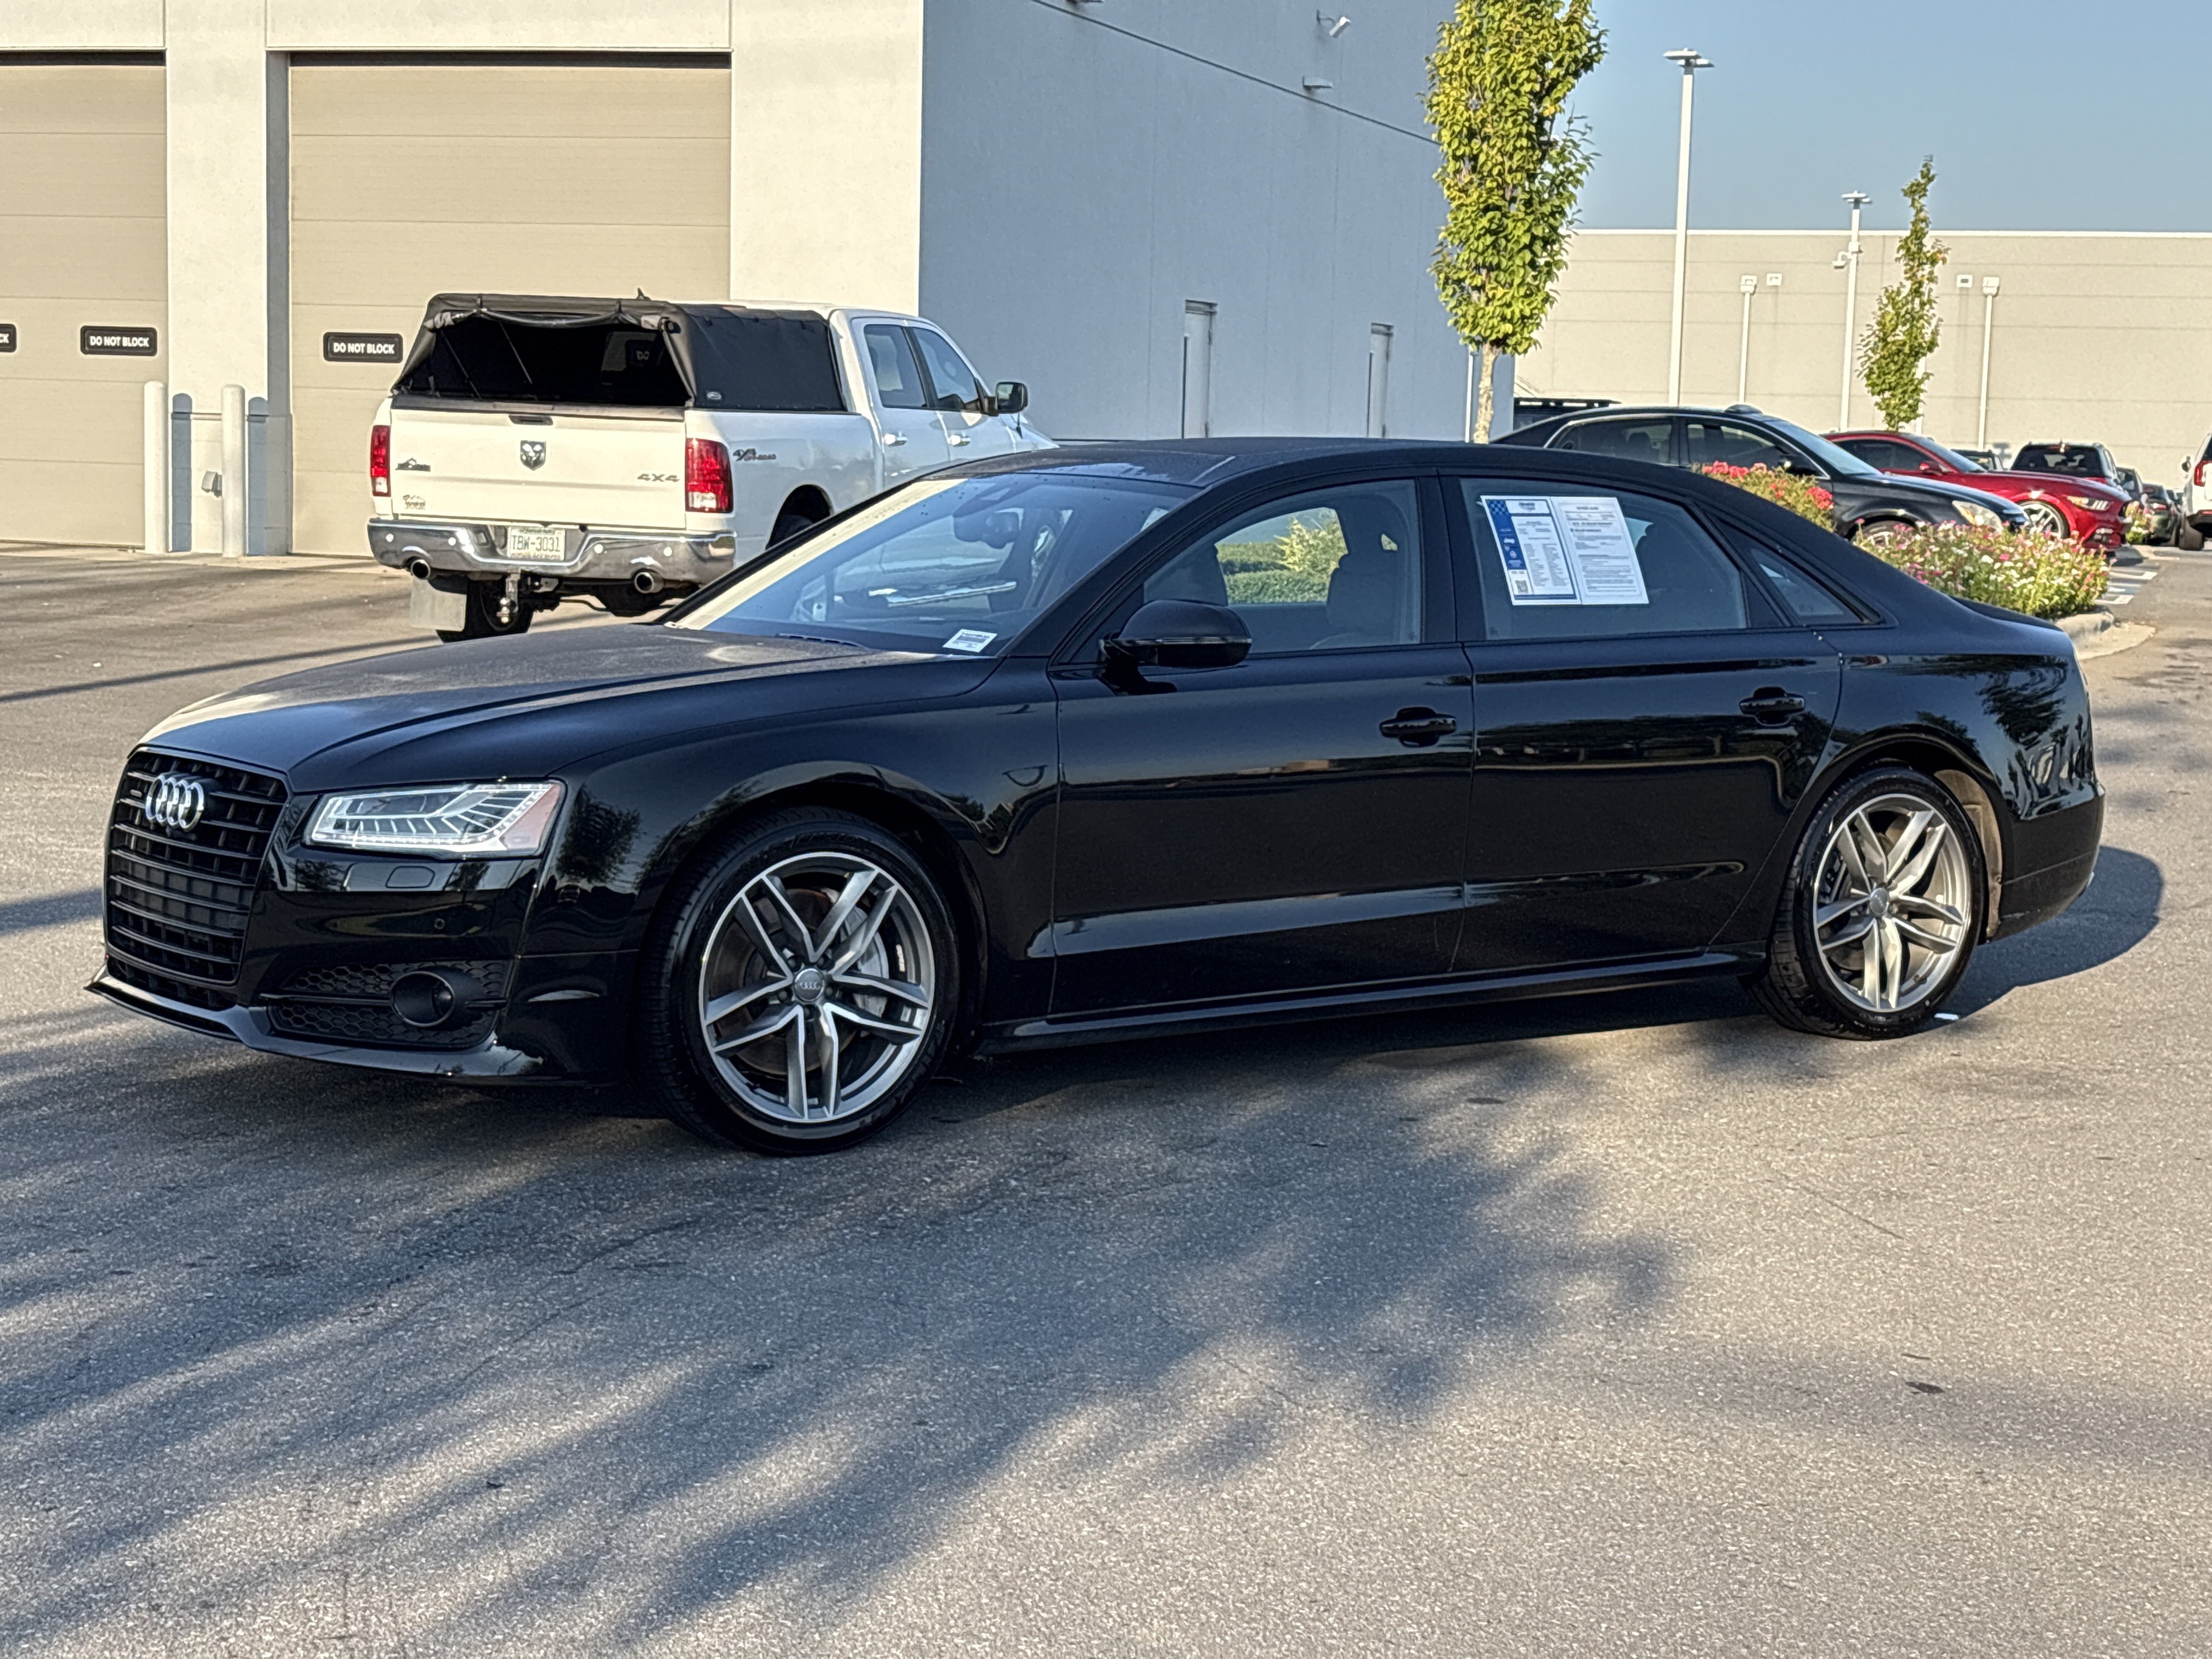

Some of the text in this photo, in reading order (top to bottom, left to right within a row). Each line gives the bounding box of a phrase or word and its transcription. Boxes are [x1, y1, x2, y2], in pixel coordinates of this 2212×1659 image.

[89, 336, 149, 347] DO NOT BLOCK
[333, 342, 394, 354] DO NOT BLOCK
